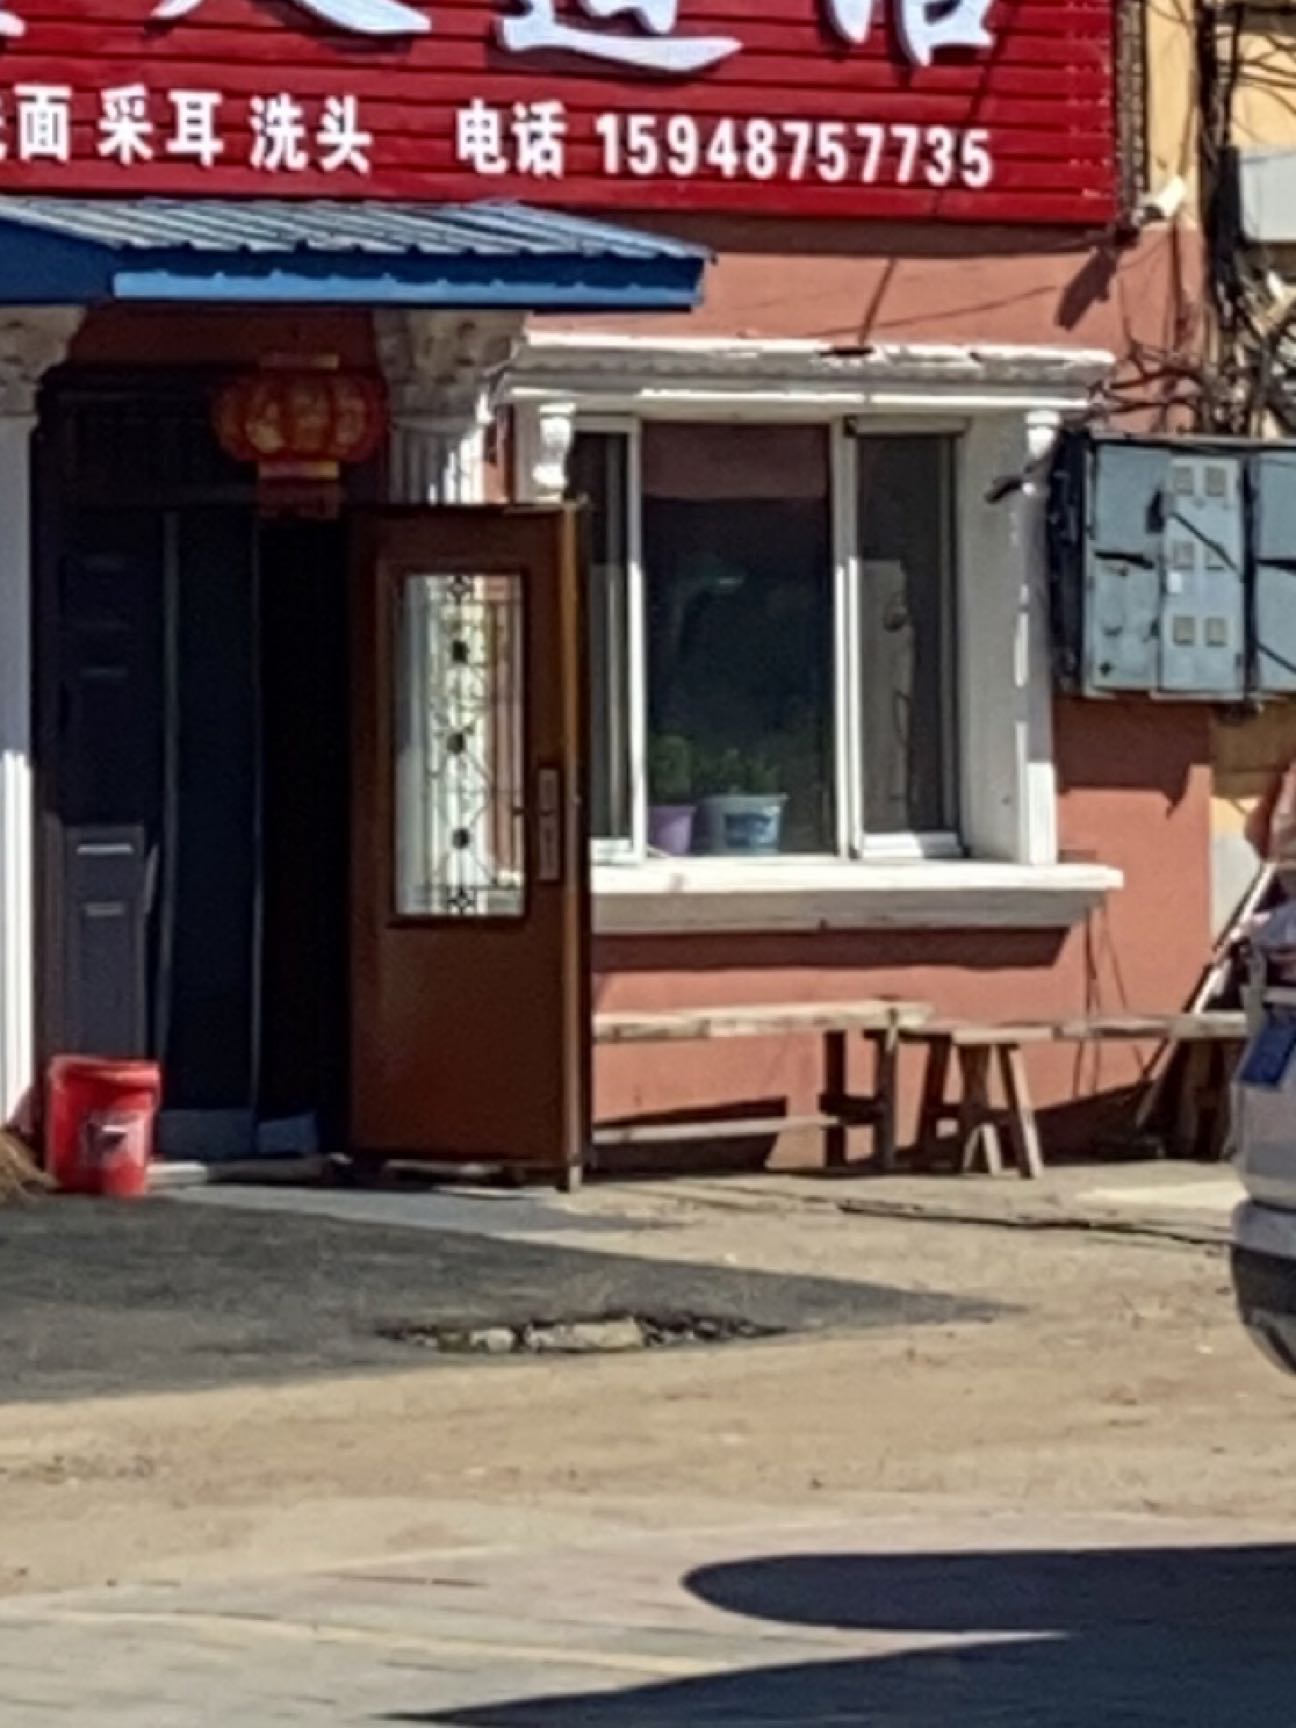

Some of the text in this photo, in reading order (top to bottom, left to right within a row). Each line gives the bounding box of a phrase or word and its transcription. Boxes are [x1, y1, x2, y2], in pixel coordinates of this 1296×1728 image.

[96, 82, 225, 167] 采耳
[248, 91, 373, 173] 洗头
[455, 96, 567, 177] 电话
[594, 111, 993, 189] 15948757735
